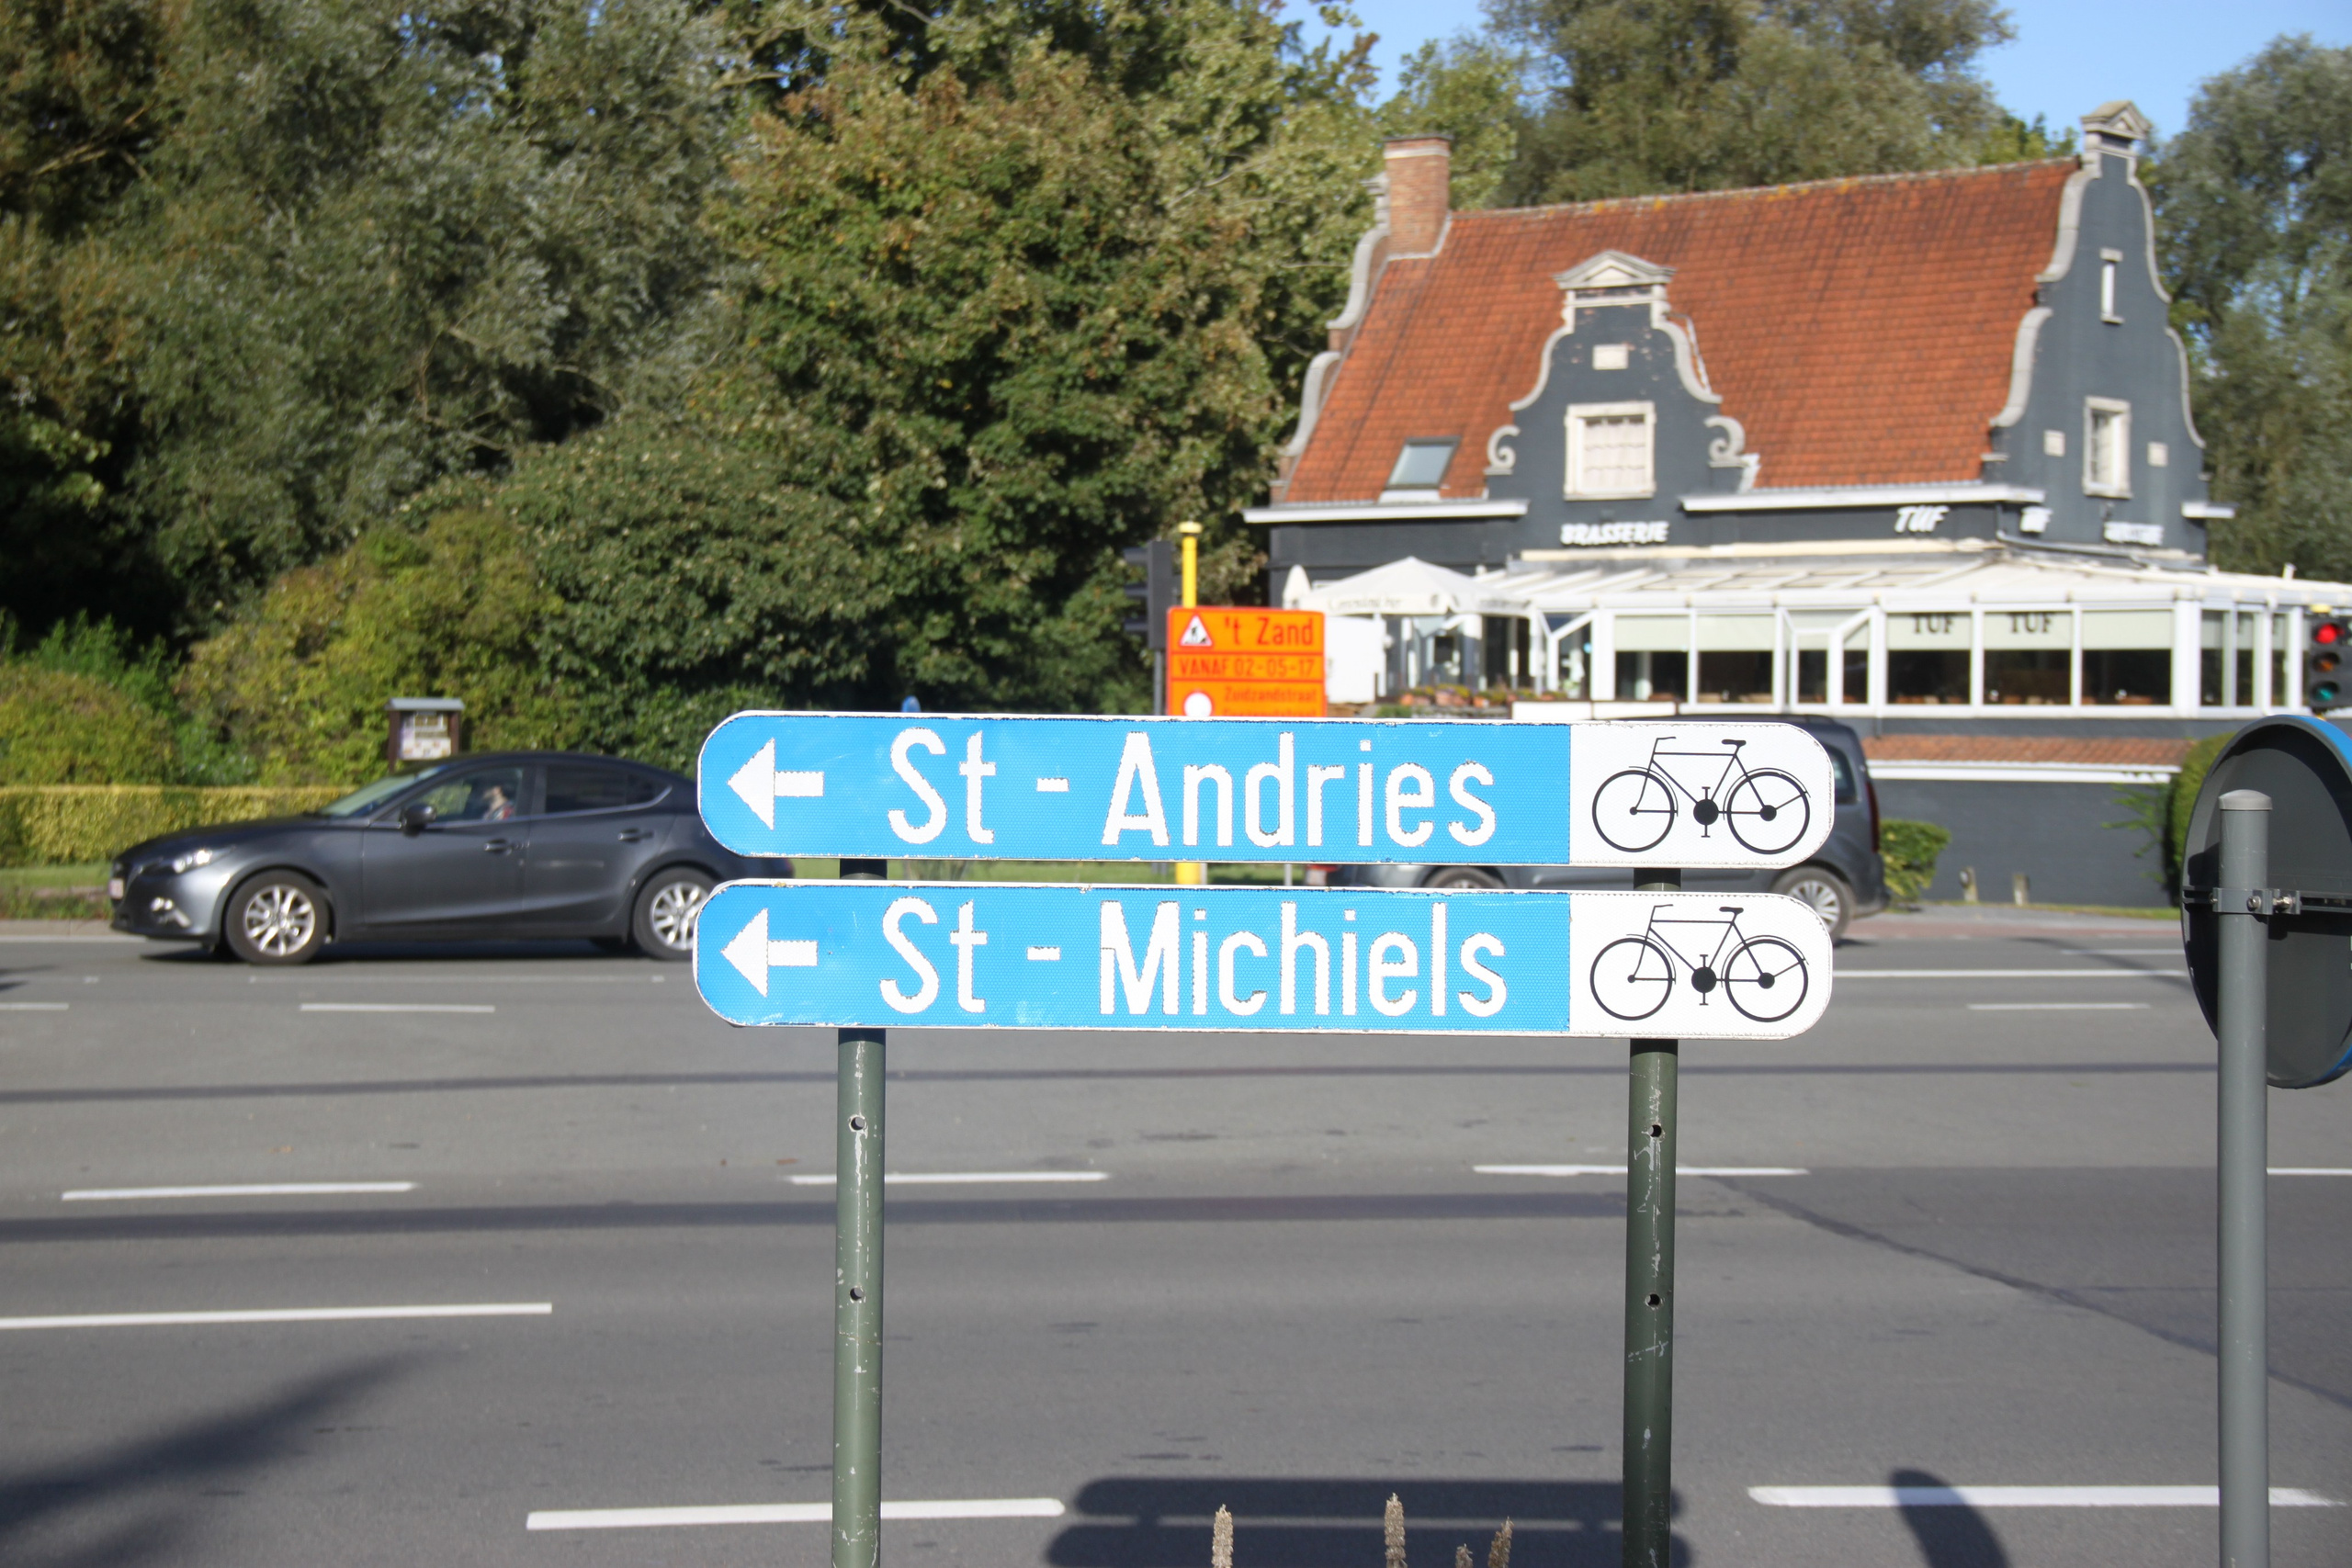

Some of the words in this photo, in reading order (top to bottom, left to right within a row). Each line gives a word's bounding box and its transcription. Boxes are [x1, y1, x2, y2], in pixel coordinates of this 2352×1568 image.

[1560, 521, 1668, 545] BRASSERIE
[1225, 616, 1241, 645] 't
[1257, 617, 1314, 646] Zand
[1179, 657, 1228, 675] VANAF
[888, 727, 997, 844] St
[1102, 731, 1496, 847] Andries
[879, 896, 988, 1014] St
[1100, 900, 1508, 1017] Michiels
